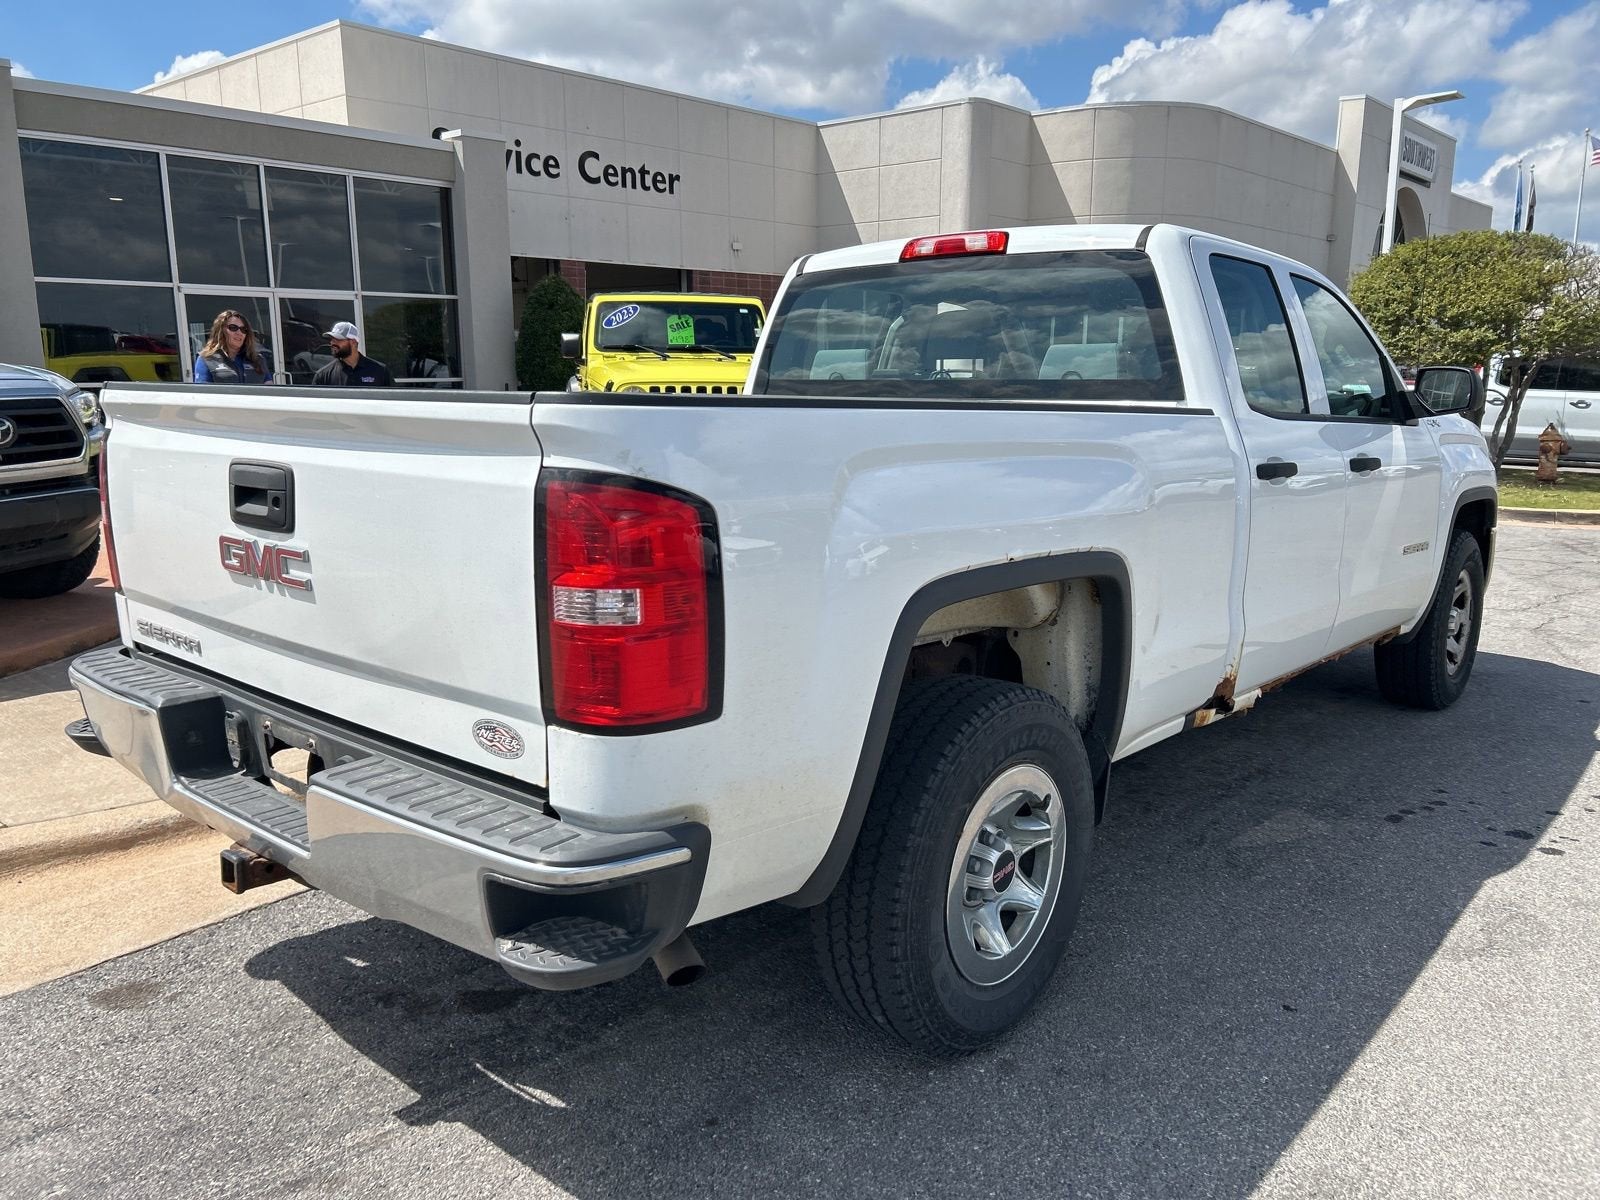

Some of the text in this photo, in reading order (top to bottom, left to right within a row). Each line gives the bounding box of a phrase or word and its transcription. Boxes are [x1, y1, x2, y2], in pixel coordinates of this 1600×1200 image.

[1402, 135, 1436, 173] SOUTHWEST
[578, 150, 680, 194] Center
[610, 306, 634, 326] 2023
[669, 319, 692, 333] SALE
[219, 535, 313, 591] GMC
[136, 618, 203, 657] SIERRA
[478, 728, 520, 749] NESTER
[993, 860, 1015, 884] GMC
